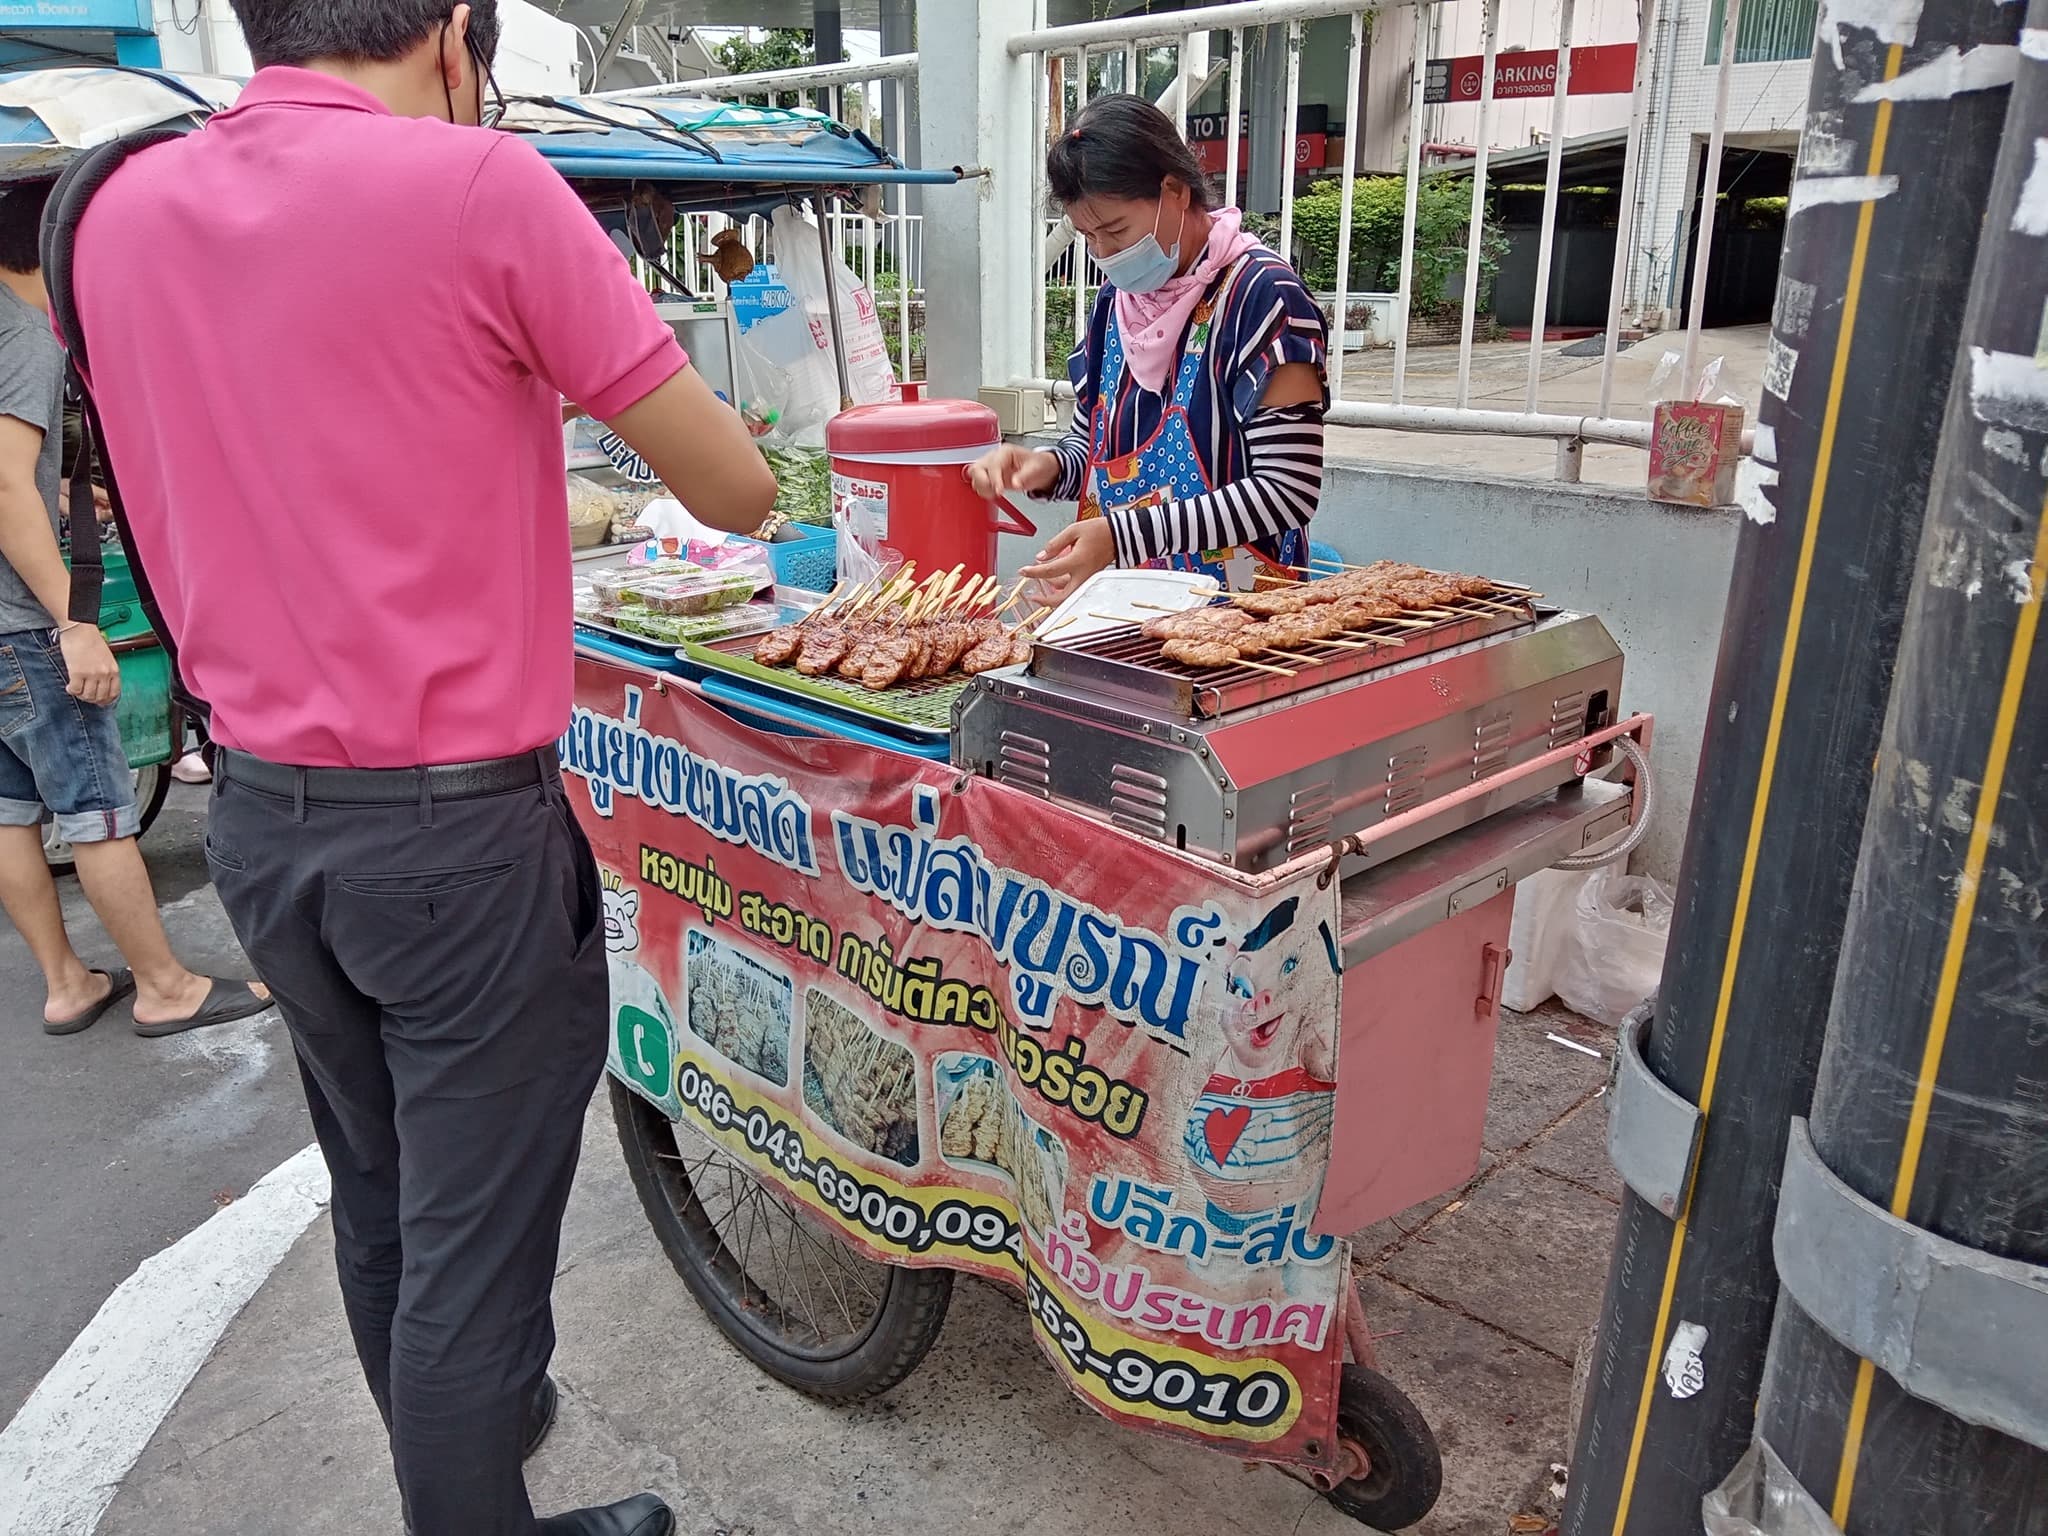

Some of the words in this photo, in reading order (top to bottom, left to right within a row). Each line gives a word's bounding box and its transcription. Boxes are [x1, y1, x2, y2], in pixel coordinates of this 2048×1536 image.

[1495, 64, 1556, 83] ARKING
[1193, 117, 1214, 137] TO
[1218, 114, 1249, 136] TE
[640, 846, 733, 923] หอมนุ่ม
[739, 893, 831, 963] สะอาด
[1047, 1216, 1328, 1346] ทั่วประเทศ
